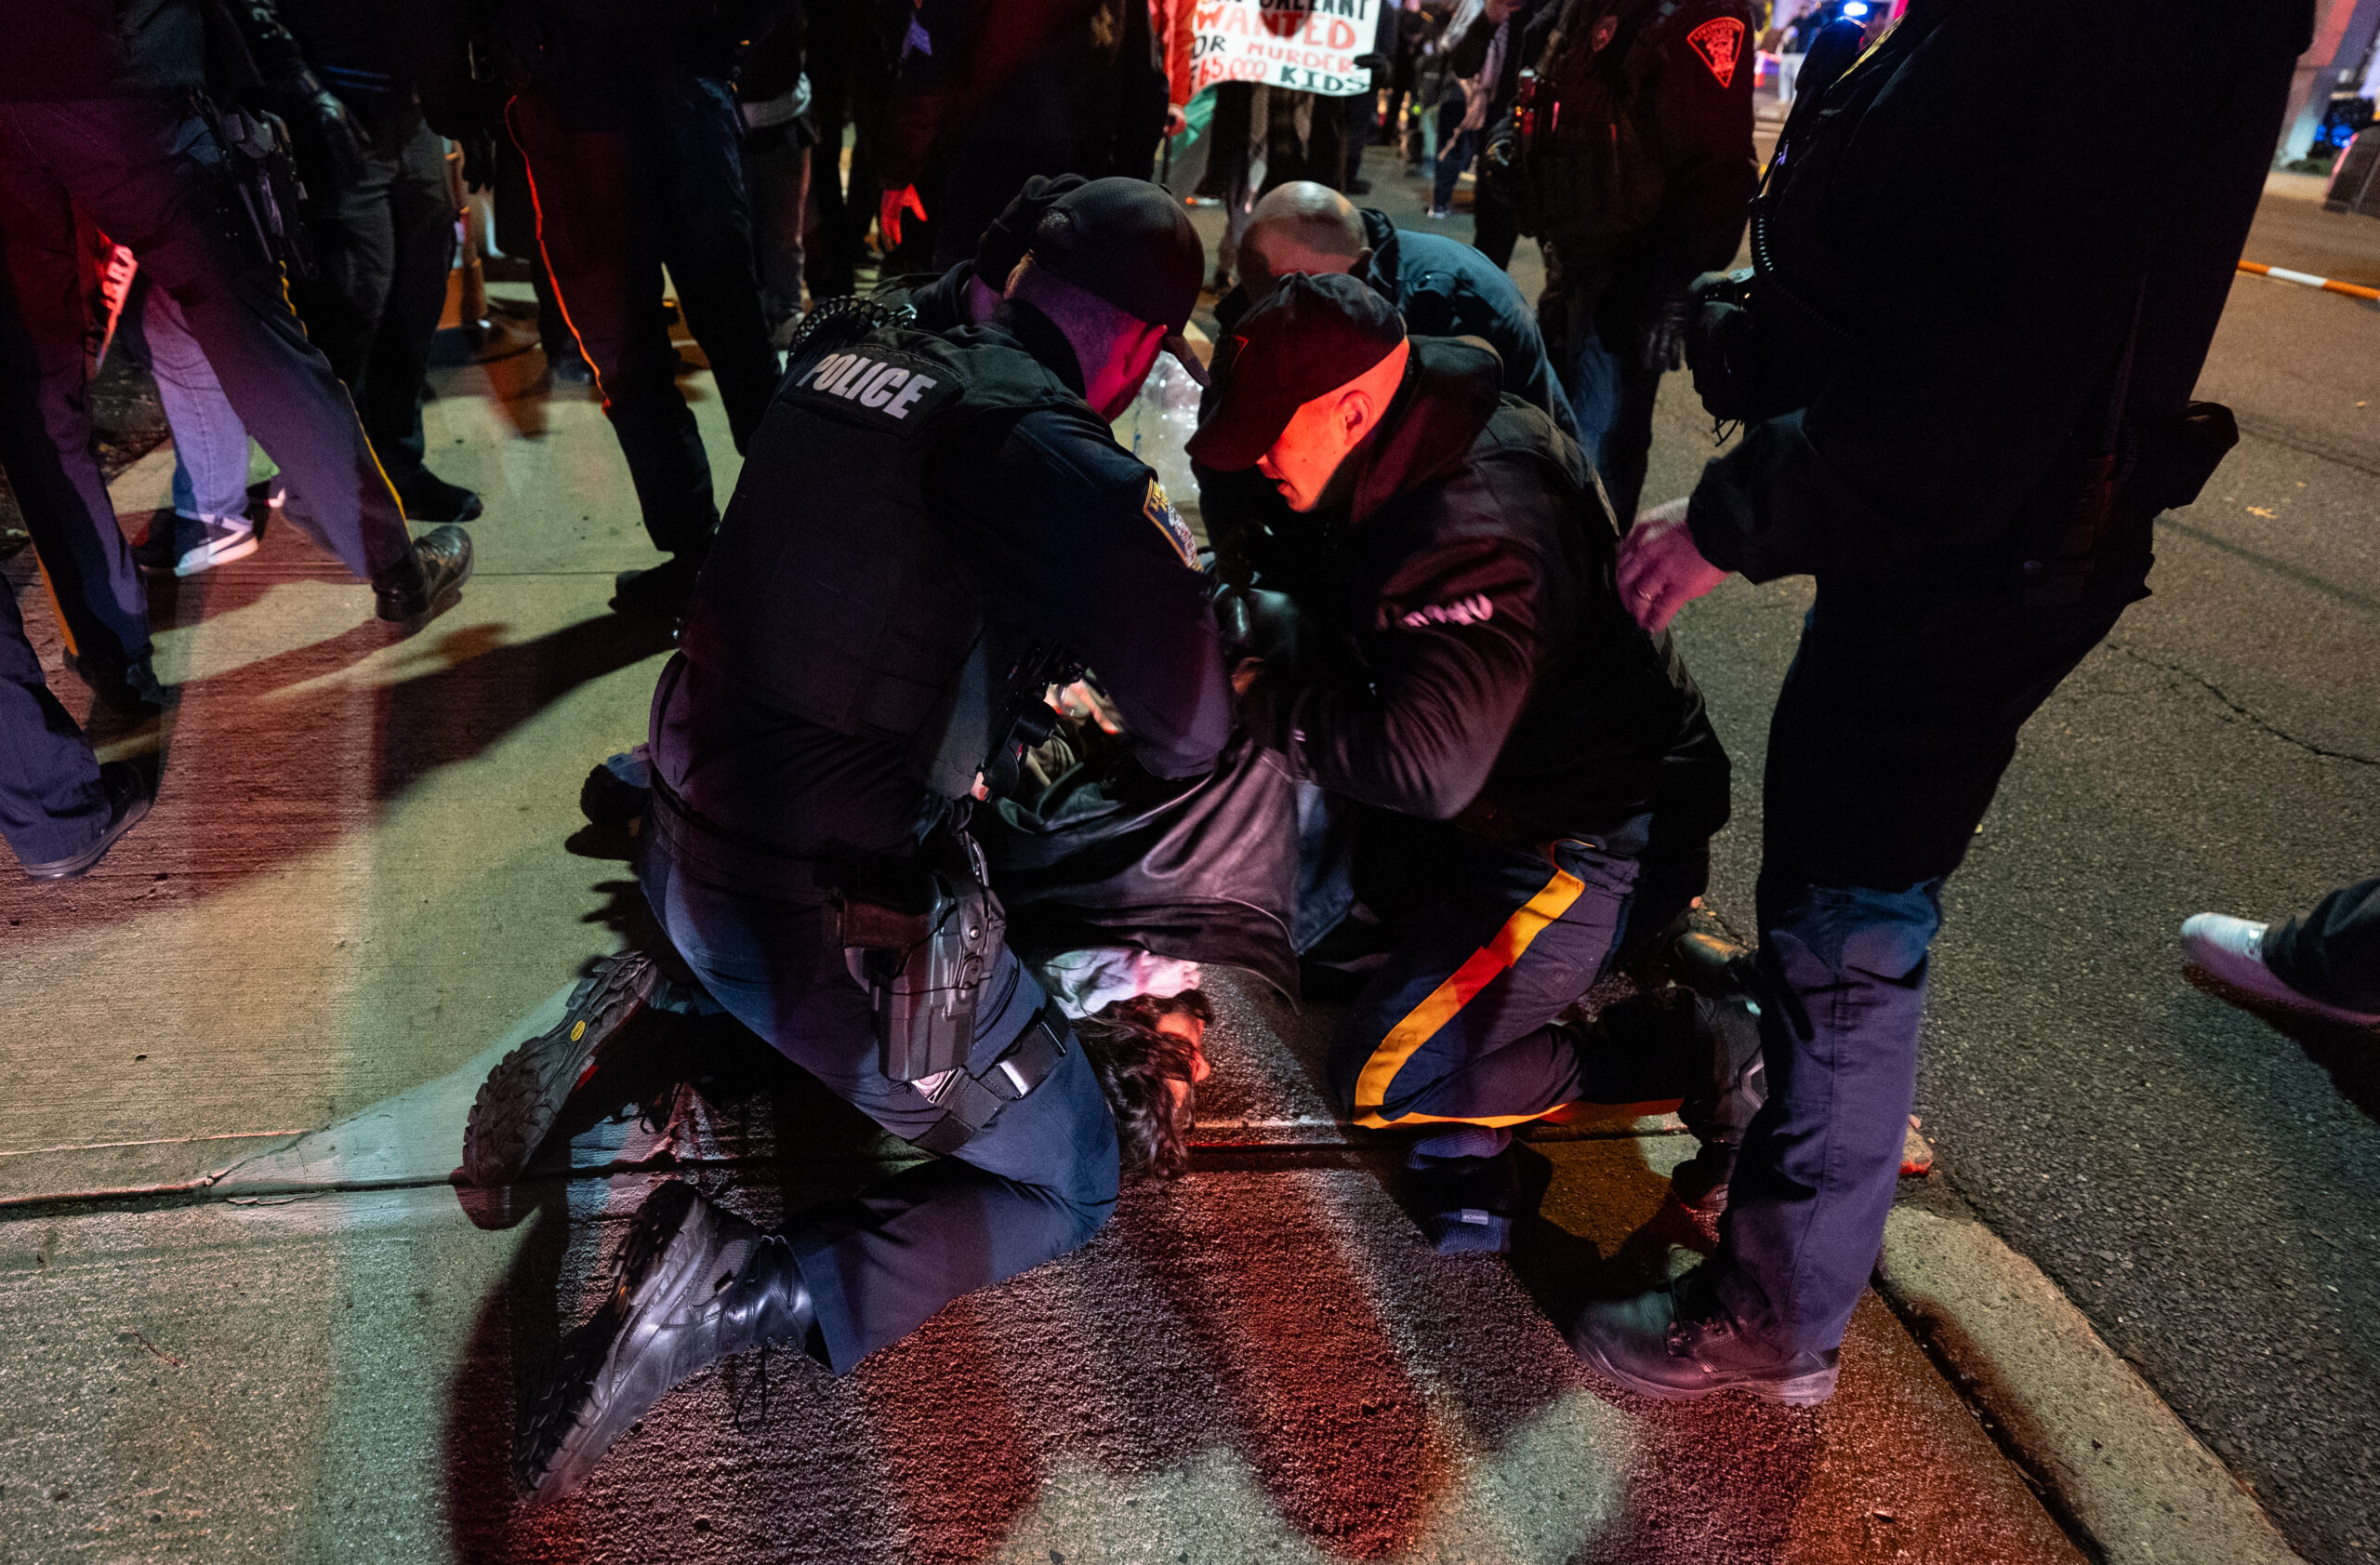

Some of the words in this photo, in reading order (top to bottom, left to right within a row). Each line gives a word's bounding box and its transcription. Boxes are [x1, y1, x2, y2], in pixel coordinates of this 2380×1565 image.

[1197, 5, 1355, 50] WANTED
[1192, 35, 1225, 60] OR
[1247, 43, 1354, 73] MURDER
[1280, 65, 1369, 92] KIDS
[796, 353, 937, 419] POLICE
